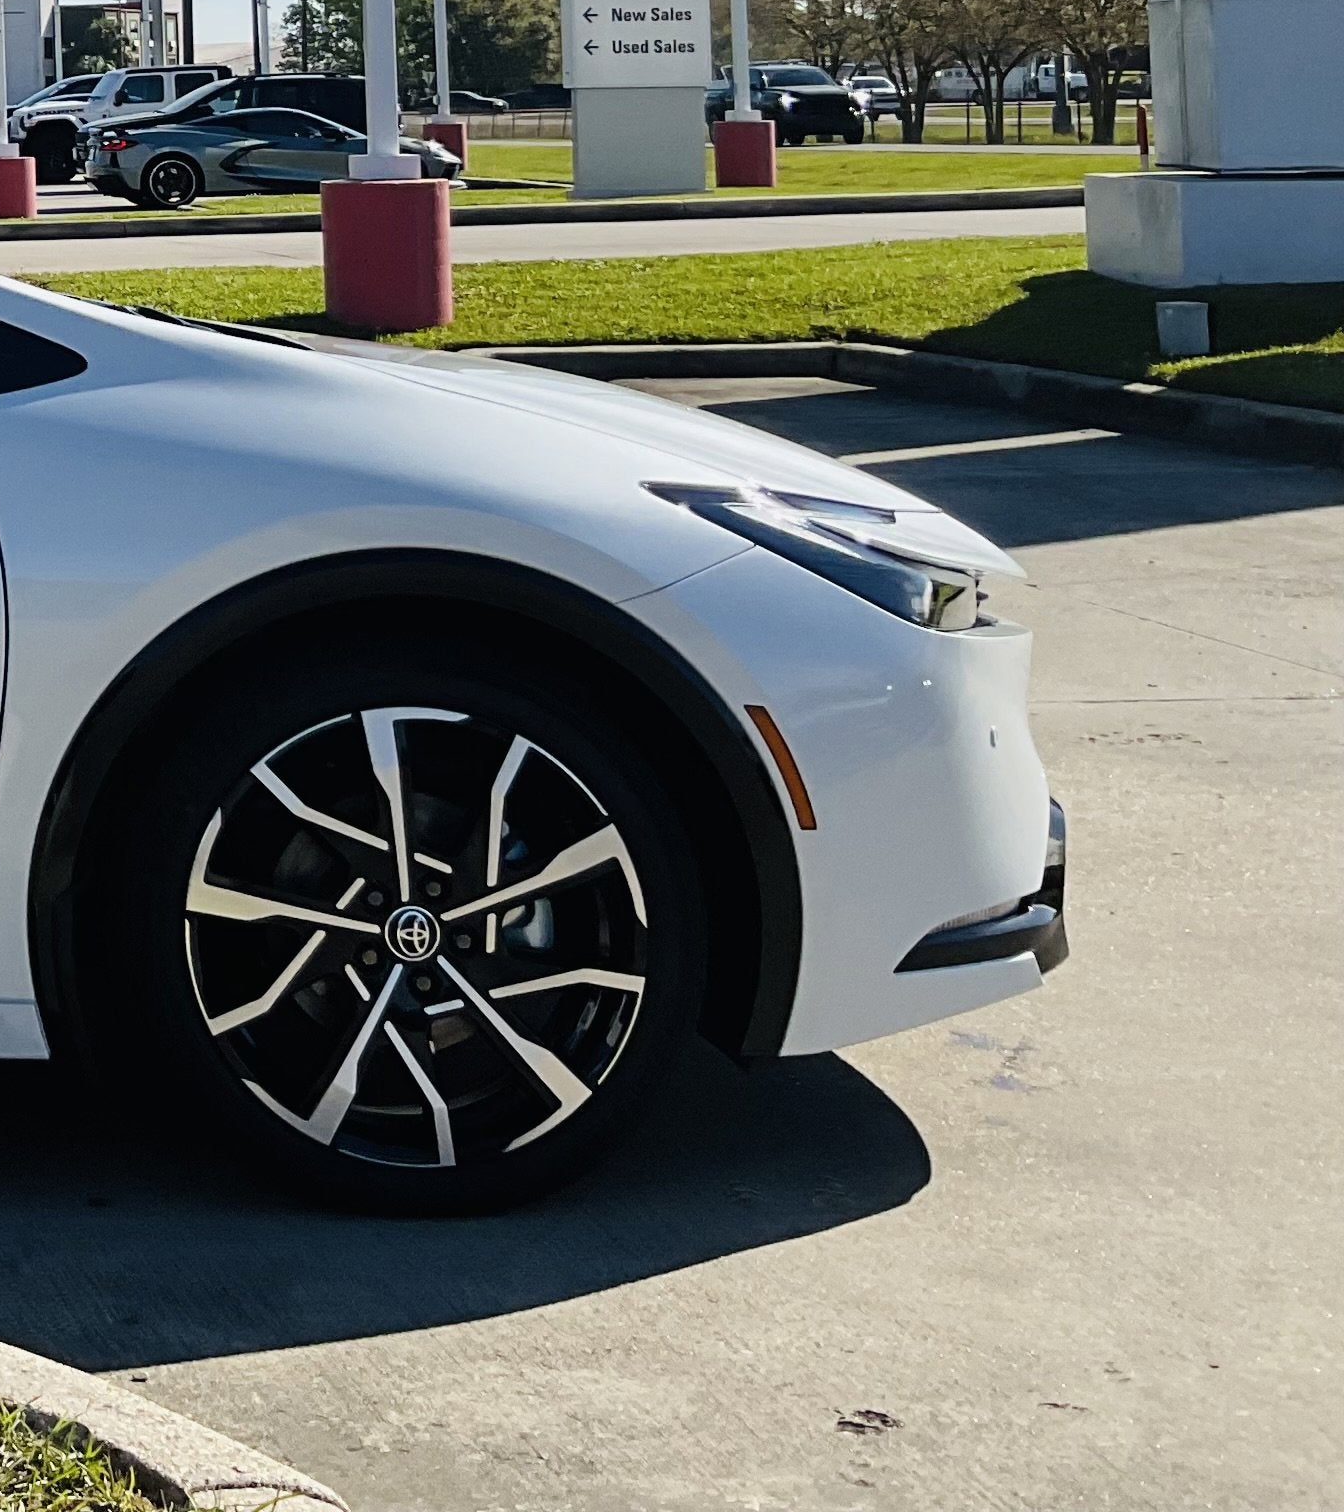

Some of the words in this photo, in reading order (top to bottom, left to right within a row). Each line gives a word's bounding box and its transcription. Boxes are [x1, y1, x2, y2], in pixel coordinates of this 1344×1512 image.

[612, 8, 646, 21] New
[651, 8, 692, 21] Sales
[613, 40, 649, 54] Used
[654, 39, 695, 53] Sales
